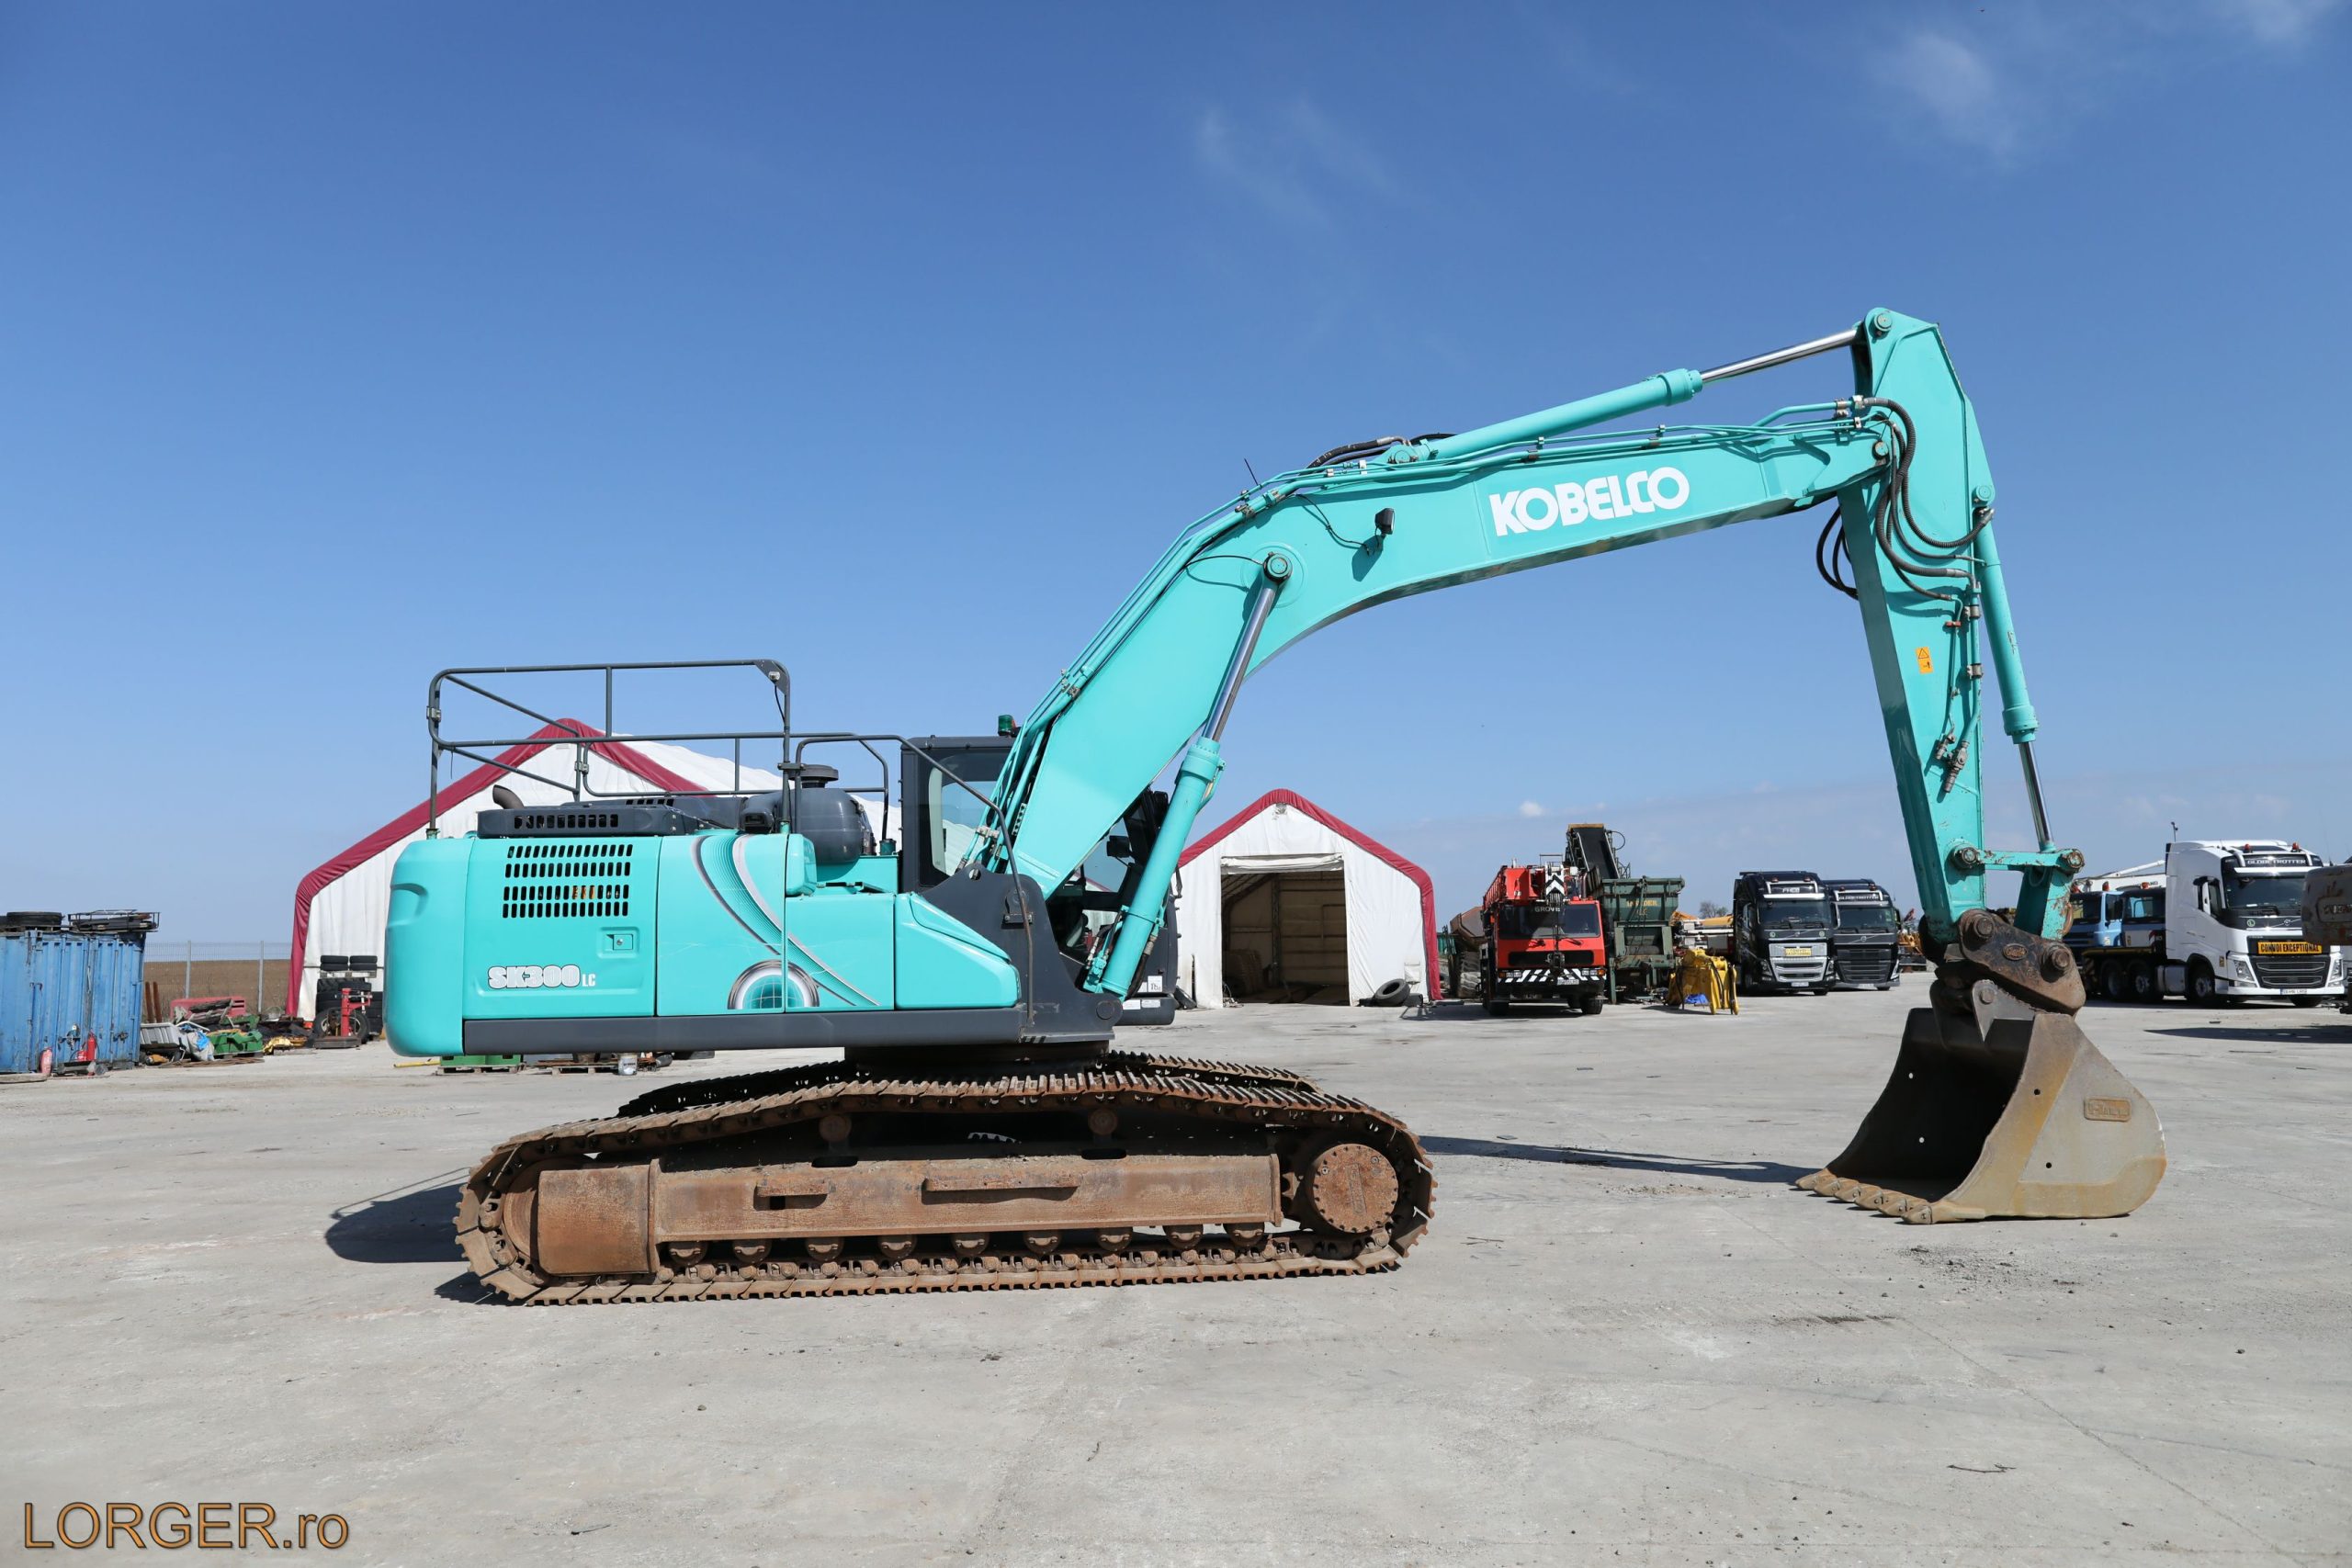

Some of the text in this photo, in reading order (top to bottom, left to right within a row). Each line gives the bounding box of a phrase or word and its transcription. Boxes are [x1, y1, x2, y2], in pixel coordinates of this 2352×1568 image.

[1489, 467, 1690, 536] KOBELCO
[488, 964, 596, 989] SK300 LC
